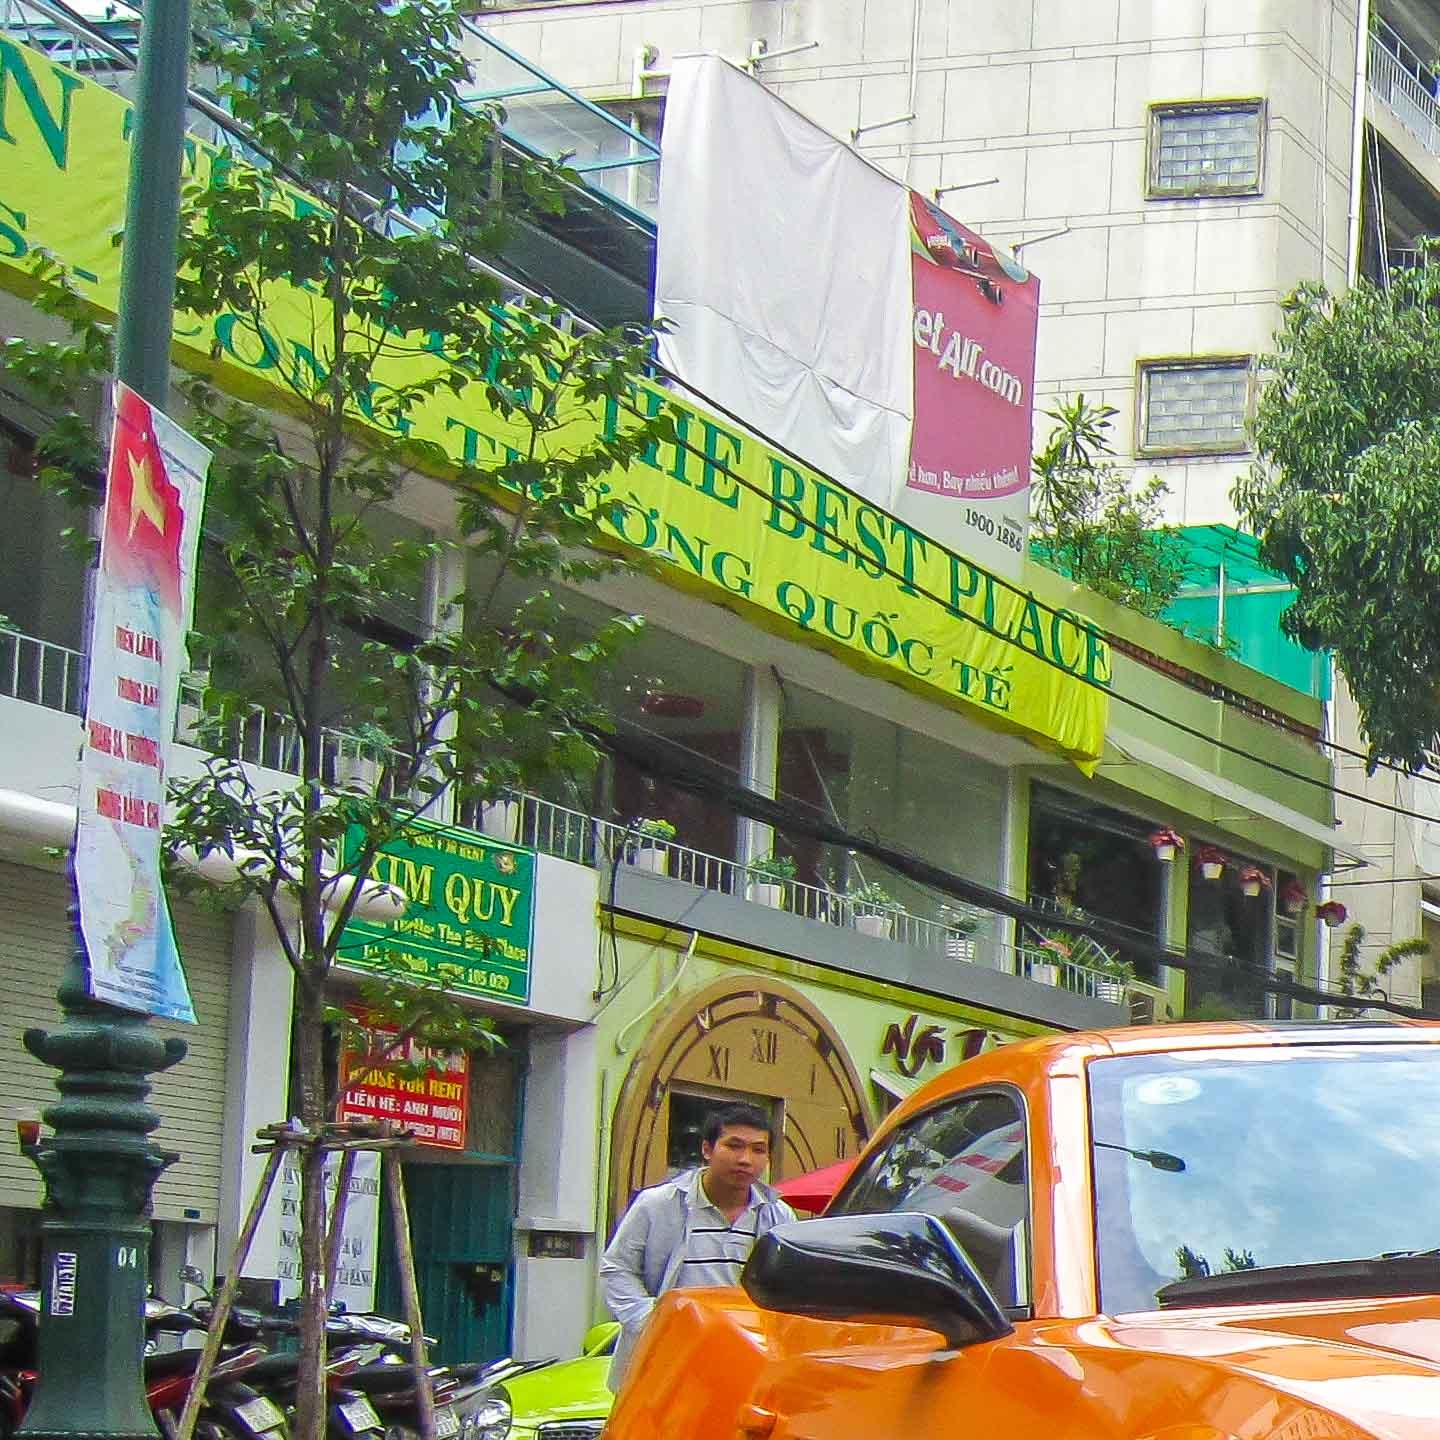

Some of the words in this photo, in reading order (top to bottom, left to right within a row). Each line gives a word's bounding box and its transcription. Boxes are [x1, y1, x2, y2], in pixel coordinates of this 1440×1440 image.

[942, 470, 963, 494] Bay
[597, 375, 742, 510] THE
[764, 457, 928, 599] BEST
[946, 555, 1113, 688] PLACE
[965, 508, 994, 537] 1900
[996, 525, 1022, 552] 1886
[776, 580, 935, 678] QUỐC
[952, 663, 1012, 713] TẾ
[369, 851, 435, 906] KIM
[444, 872, 521, 927] QUY
[429, 1079, 464, 1101] RENT
[404, 1101, 429, 1117] ANH
[117, 1247, 137, 1270] 04
